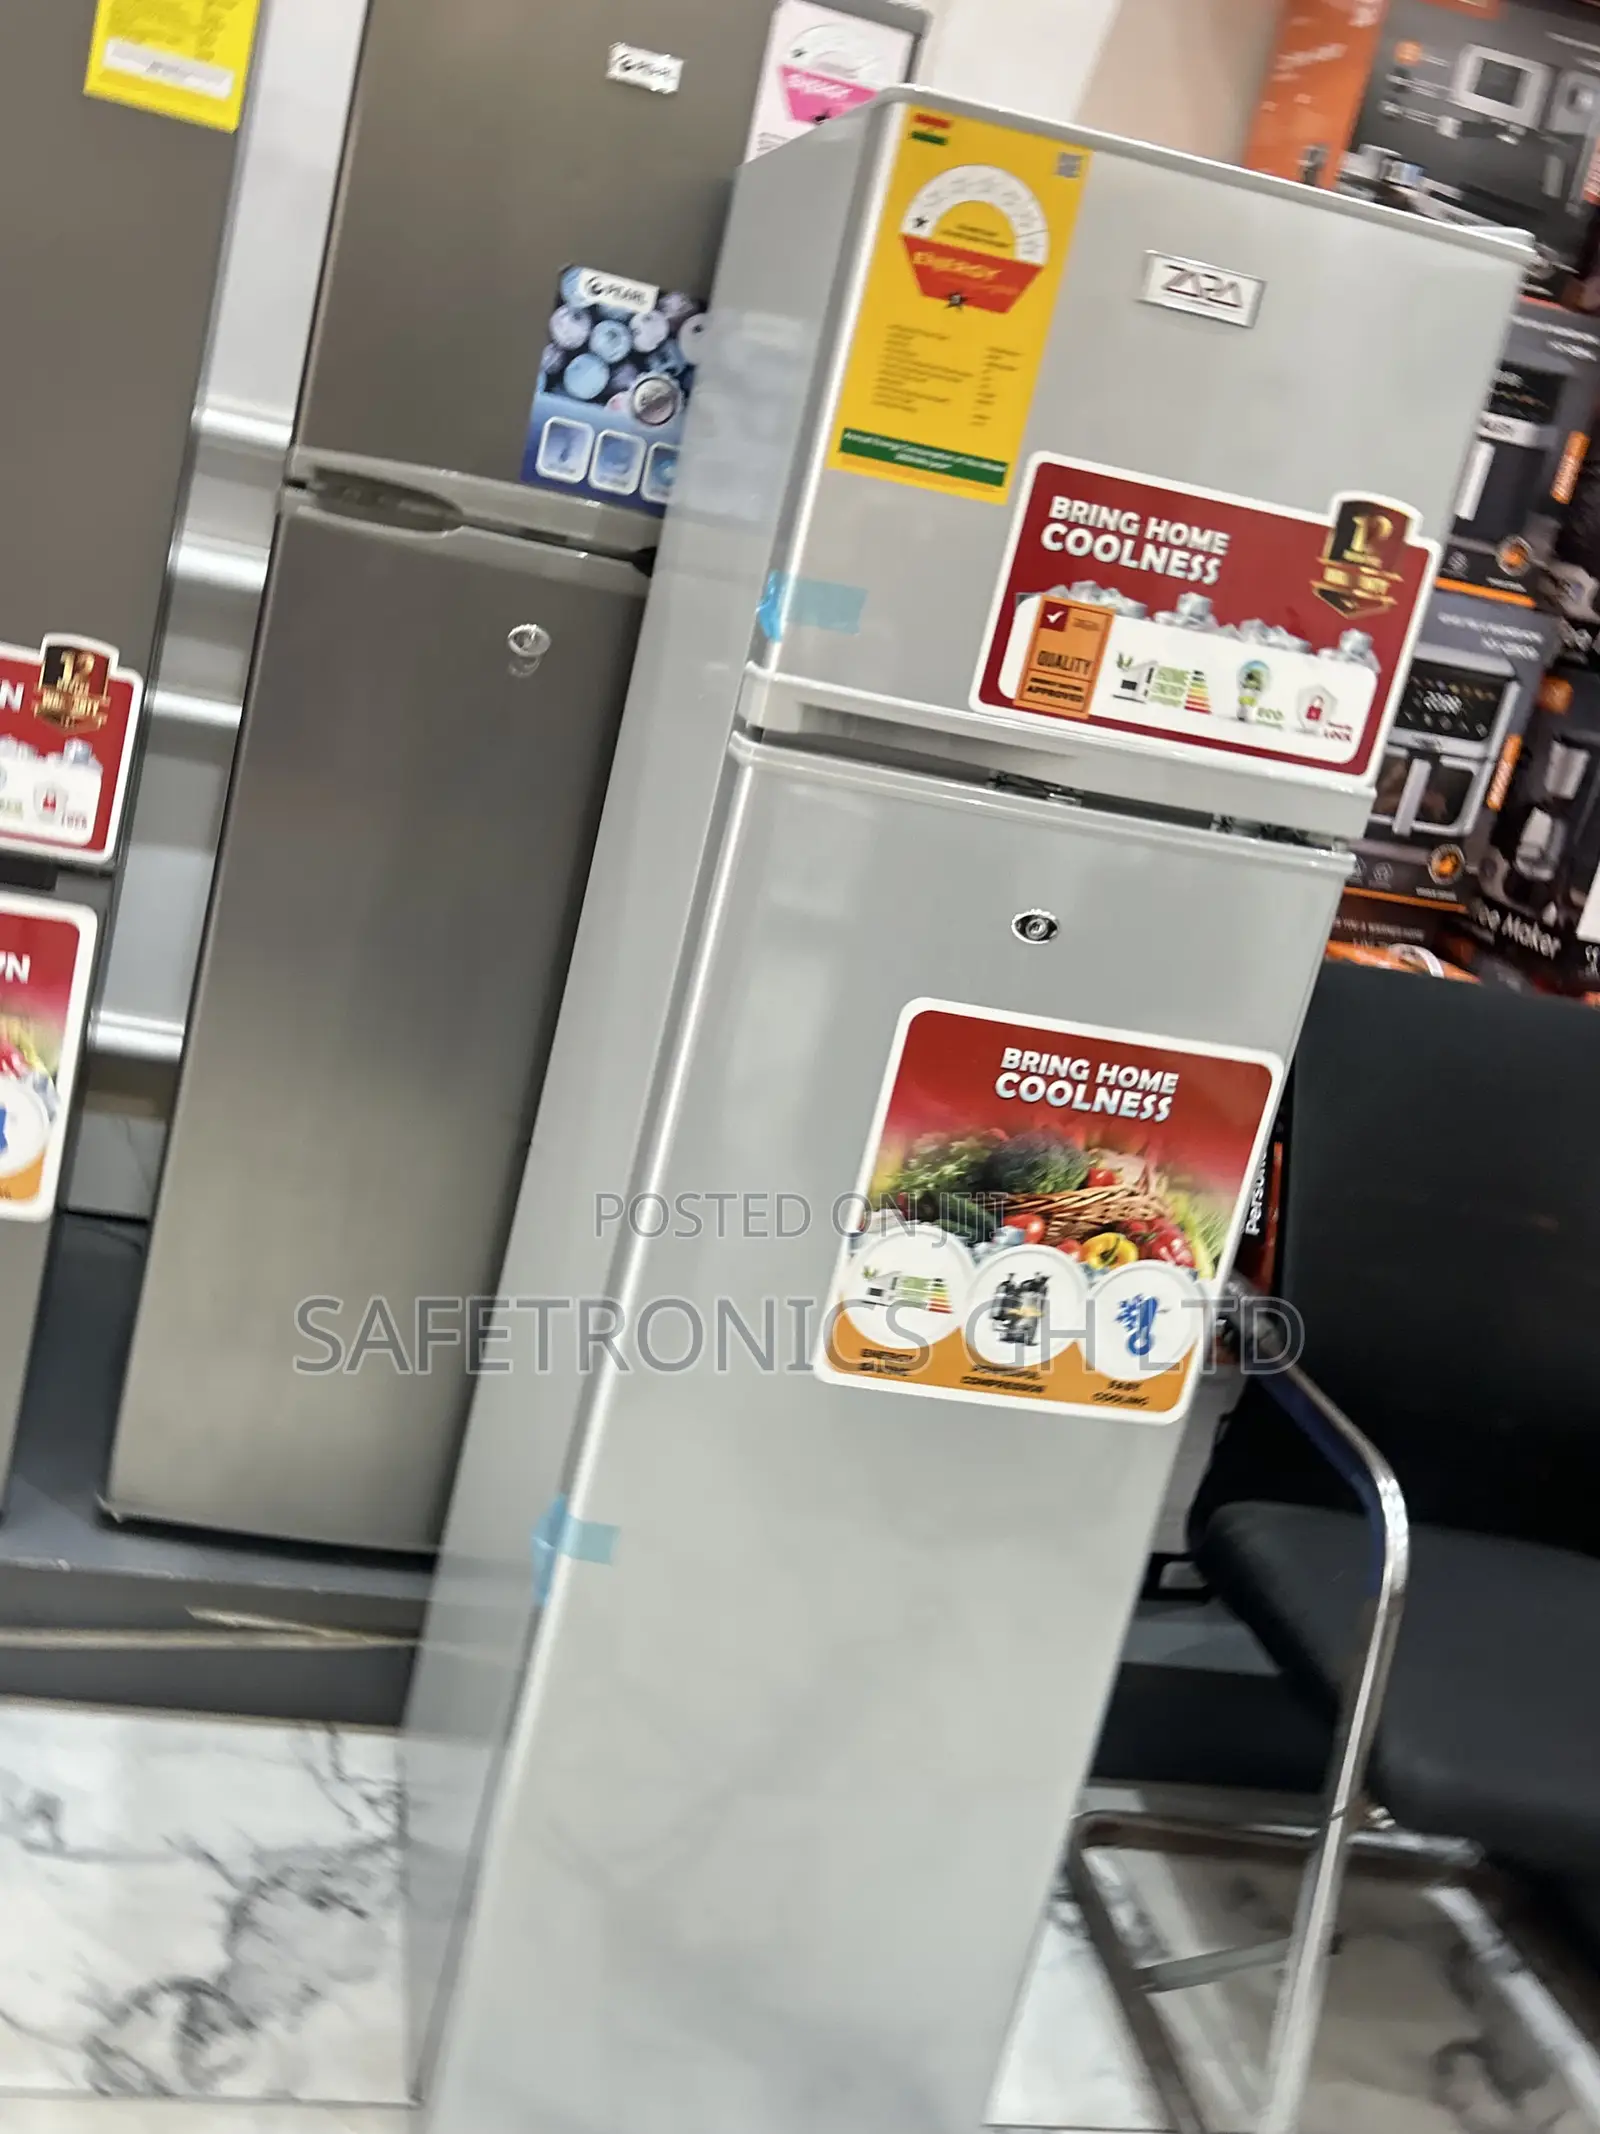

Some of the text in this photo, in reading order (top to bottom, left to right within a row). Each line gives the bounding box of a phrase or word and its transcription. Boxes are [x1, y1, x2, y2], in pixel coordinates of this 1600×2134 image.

[1048, 495, 1231, 556] BRING HOME
[1040, 522, 1220, 585] COOLNESS
[1037, 650, 1093, 676] QUALITY
[1501, 911, 1562, 960] Maker
[1000, 1047, 1180, 1095] BRING HOME
[994, 1071, 1173, 1124] COOLNESS
